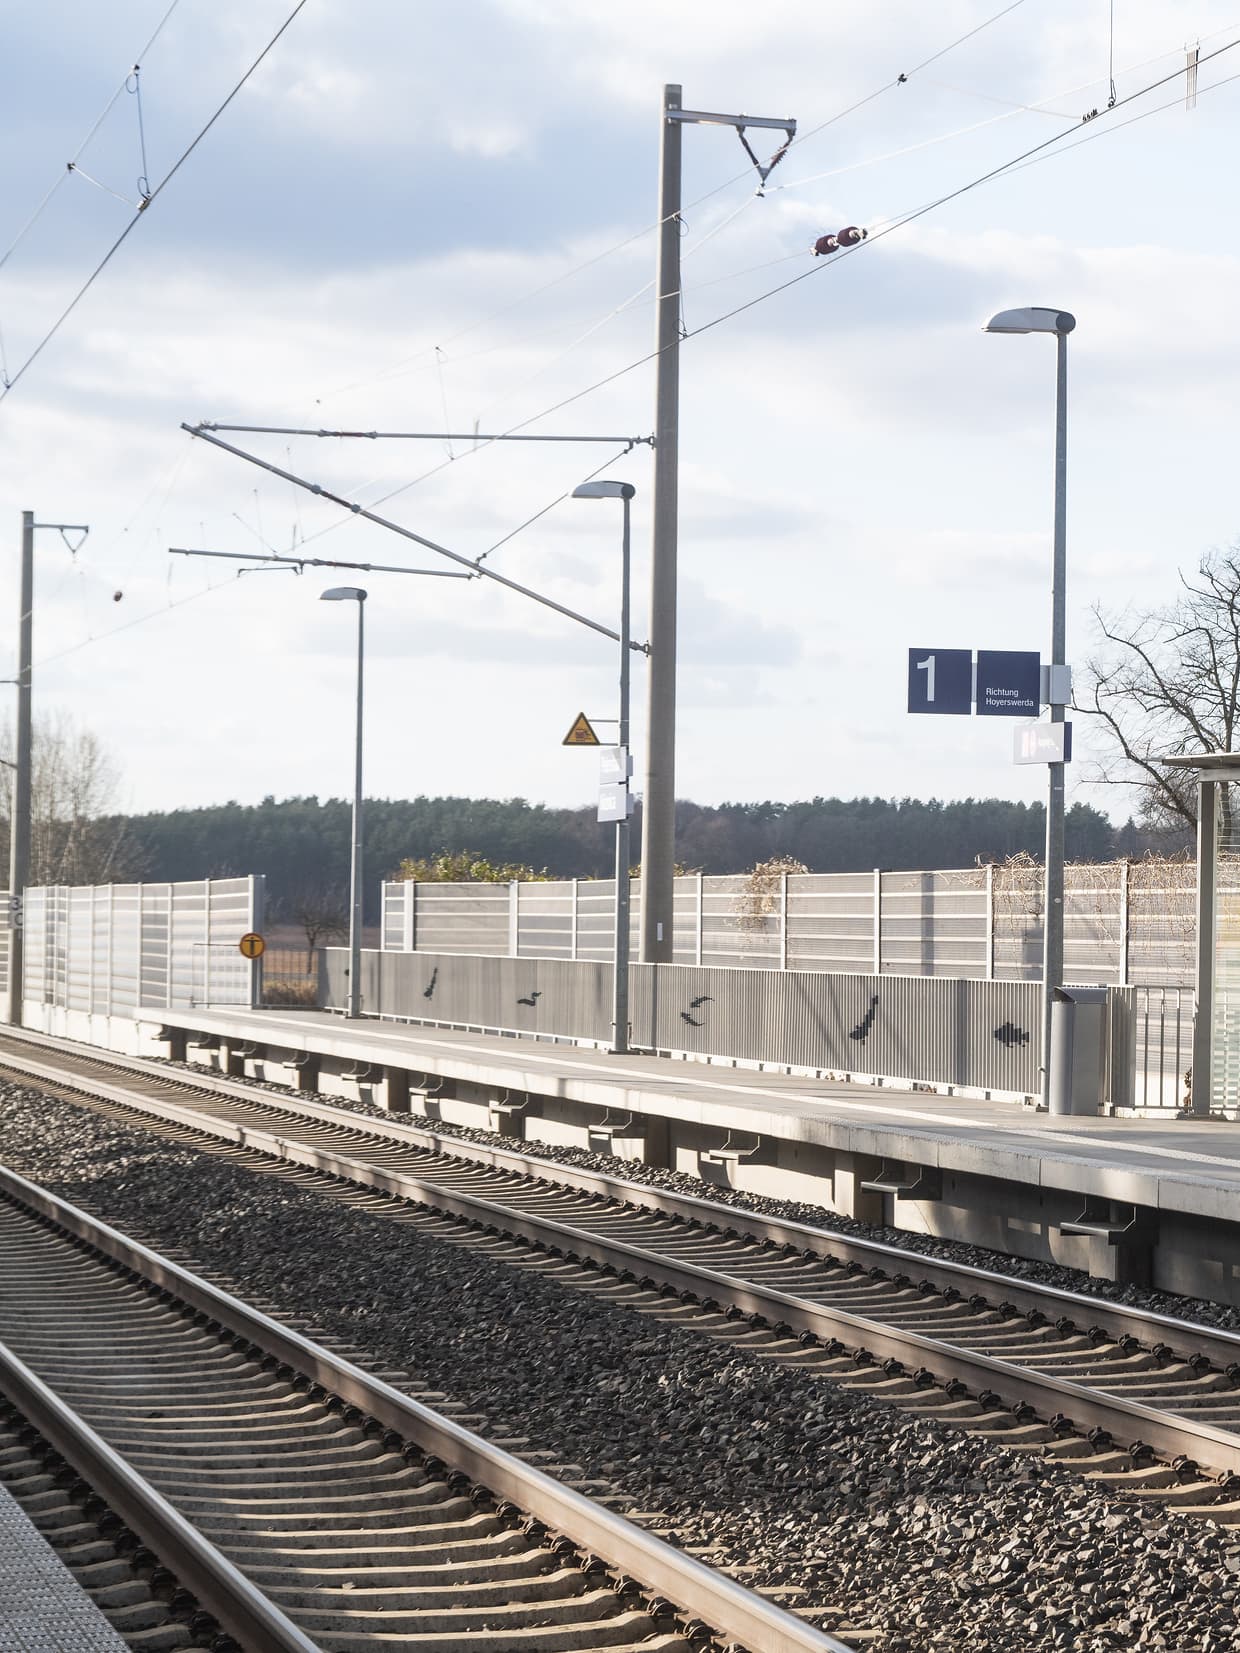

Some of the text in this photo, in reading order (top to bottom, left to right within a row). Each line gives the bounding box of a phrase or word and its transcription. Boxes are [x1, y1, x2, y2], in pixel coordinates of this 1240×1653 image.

[917, 655, 936, 702] 1
[986, 687, 1019, 698] Richtung
[985, 697, 1034, 708] Hoyerswerda
